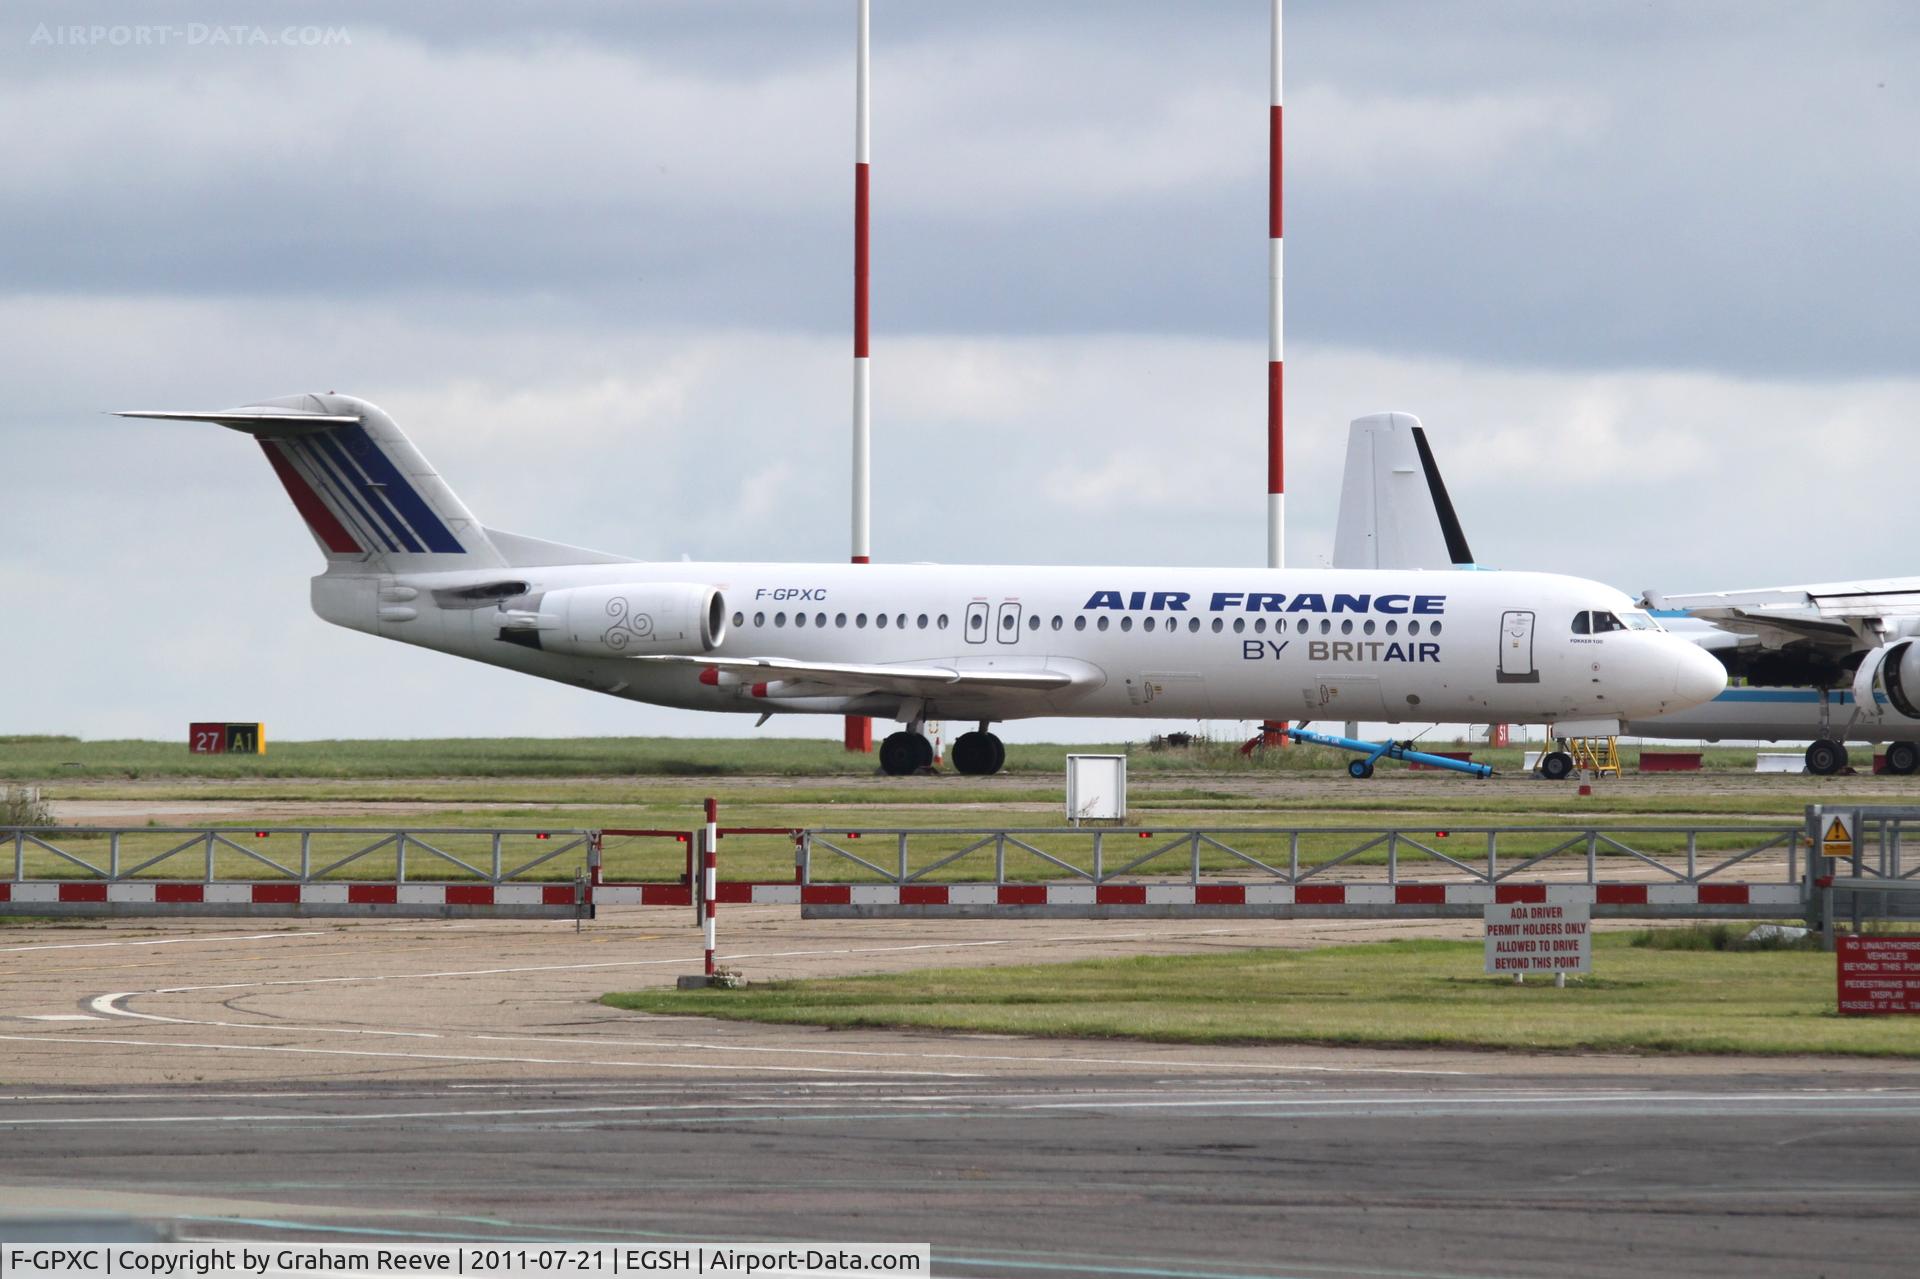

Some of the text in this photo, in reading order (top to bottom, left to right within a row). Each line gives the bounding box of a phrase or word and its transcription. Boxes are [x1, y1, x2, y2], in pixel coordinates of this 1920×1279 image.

[755, 588, 827, 601] F-GPXC
[1083, 591, 1446, 614] AIR FRANCE
[1243, 640, 1441, 662] BY BRITAIR
[196, 732, 253, 752] 27 A1
[1511, 907, 1563, 919] AOA DRIVER
[1488, 923, 1586, 936] PERMIT HOLDERS ONLY
[1496, 940, 1579, 952] ALLOWED TO DRIVE
[1846, 942, 1860, 950] NO
[1867, 952, 1908, 960] VEHICLES
[1495, 957, 1580, 969] BEYOND THIS POINT
[1844, 963, 1878, 971] BEYOND
[1881, 963, 1901, 971] THIS
[1845, 980, 1903, 988] PEDESTRIANS
[1871, 991, 1905, 999] DISPLAY
[1842, 1001, 1875, 1009] PASSES
[1878, 1001, 1888, 1009] AT
[1891, 1001, 1906, 1009] ALL
